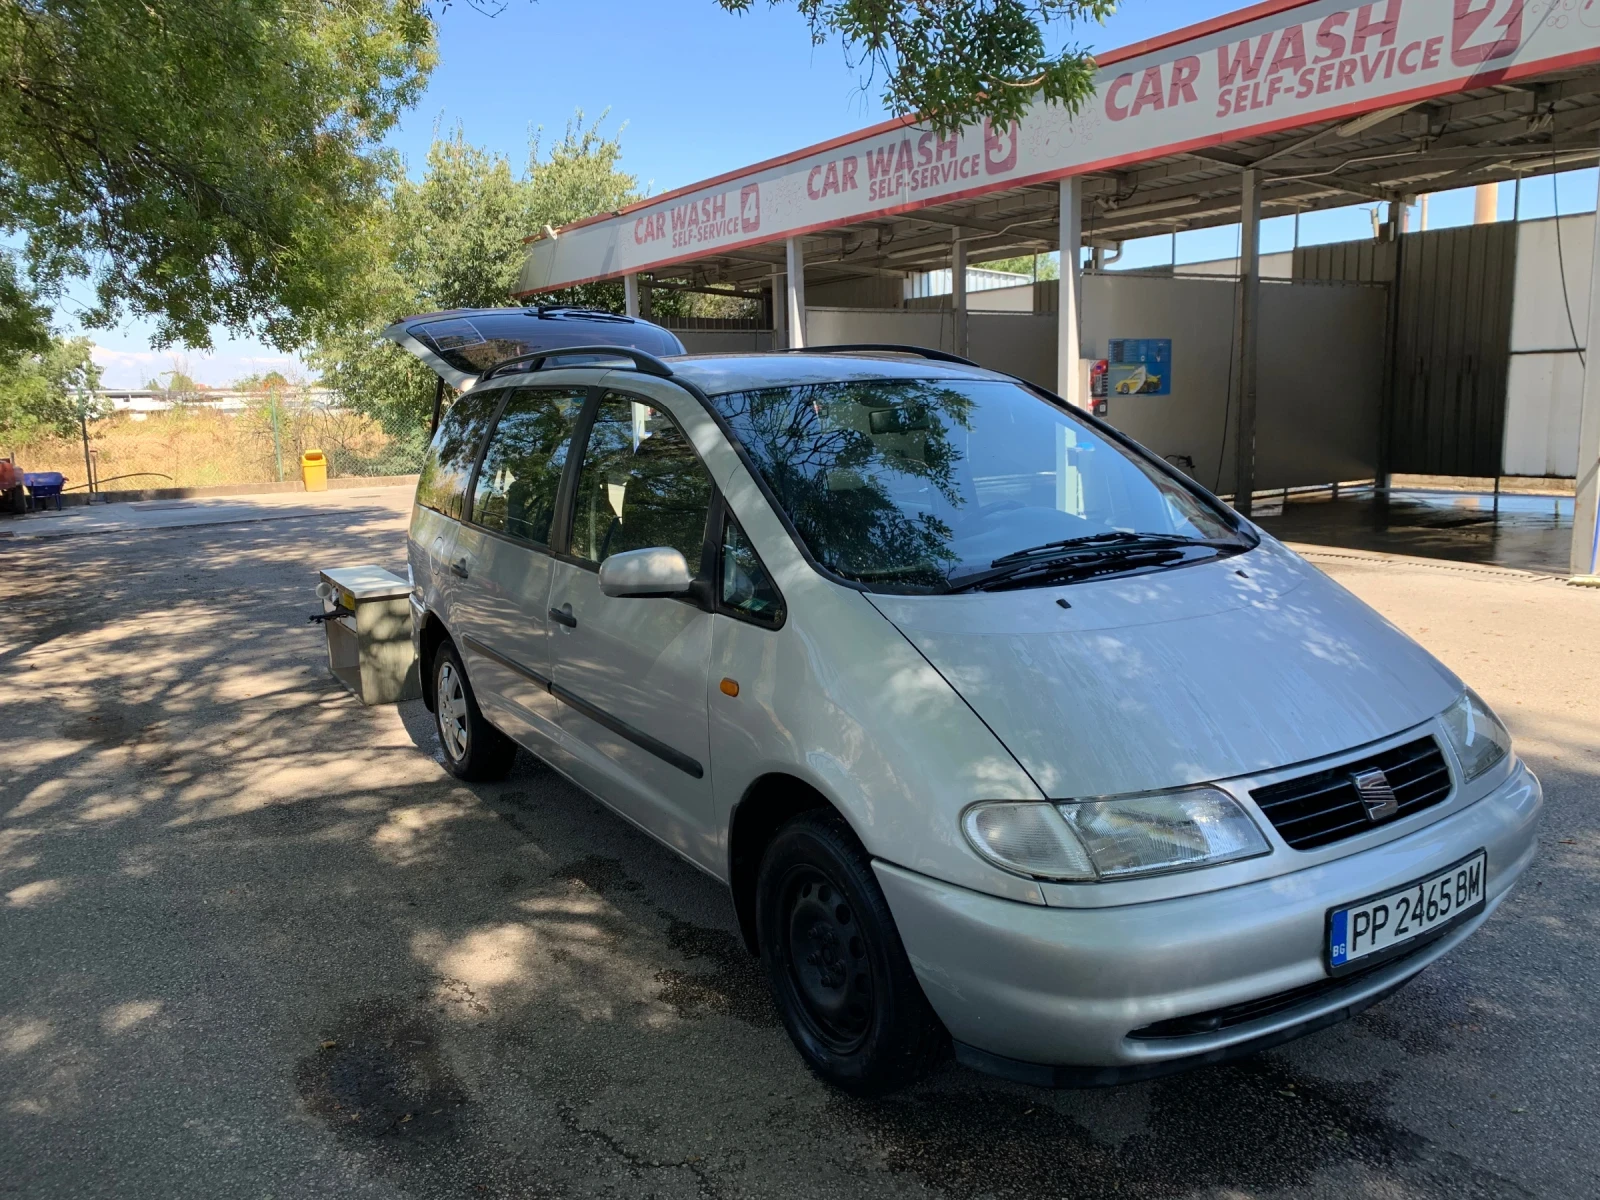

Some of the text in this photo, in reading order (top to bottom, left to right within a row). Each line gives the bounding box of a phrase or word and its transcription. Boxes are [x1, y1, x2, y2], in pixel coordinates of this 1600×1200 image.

[1104, 0, 1402, 122] CAR WASH
[1215, 35, 1444, 118] SELF-SERVICE
[807, 128, 958, 200] CAR WASH
[868, 153, 981, 201] SELF-SERVICE
[634, 192, 726, 245] CAR WASH
[672, 216, 739, 249] SELF-SERVICE
[1352, 861, 1481, 951] PP 2465 BM
[1332, 943, 1346, 957] BG
